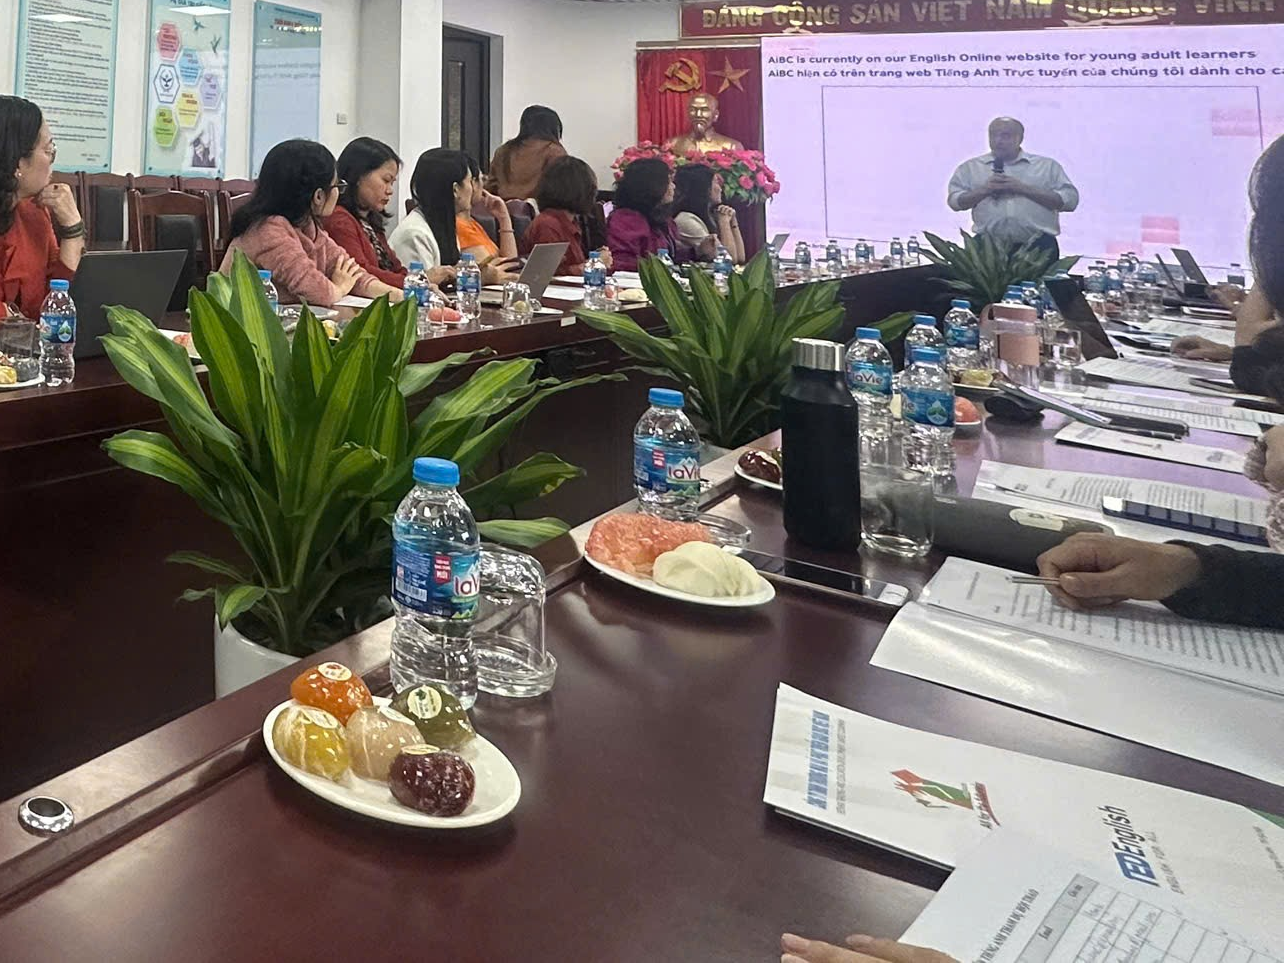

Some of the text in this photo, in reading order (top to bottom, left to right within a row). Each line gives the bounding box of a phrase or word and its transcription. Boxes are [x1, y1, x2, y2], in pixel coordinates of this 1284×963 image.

[797, 55, 806, 64] is
[809, 55, 863, 65] currently
[866, 55, 881, 63] on
[884, 55, 906, 63] our
[909, 53, 956, 64] English
[959, 53, 1002, 62] Online
[1006, 52, 1060, 61] website
[1064, 51, 1086, 61] for
[1090, 52, 1136, 62] young
[1141, 50, 1182, 60] adult
[1186, 50, 1257, 60] learners
[797, 69, 820, 78] hiện
[823, 68, 837, 78] có
[840, 68, 865, 78] trên
[869, 69, 902, 79] trang
[905, 68, 932, 77] web
[935, 67, 970, 78] Tiếng
[973, 68, 999, 77] Anh
[1003, 68, 1034, 78] Trực
[1038, 67, 1077, 78] tuyến
[1081, 67, 1106, 77] của
[1111, 66, 1158, 78] chúng
[1162, 66, 1184, 76] tôi
[1189, 65, 1230, 76] dành
[1235, 66, 1266, 76] cho
